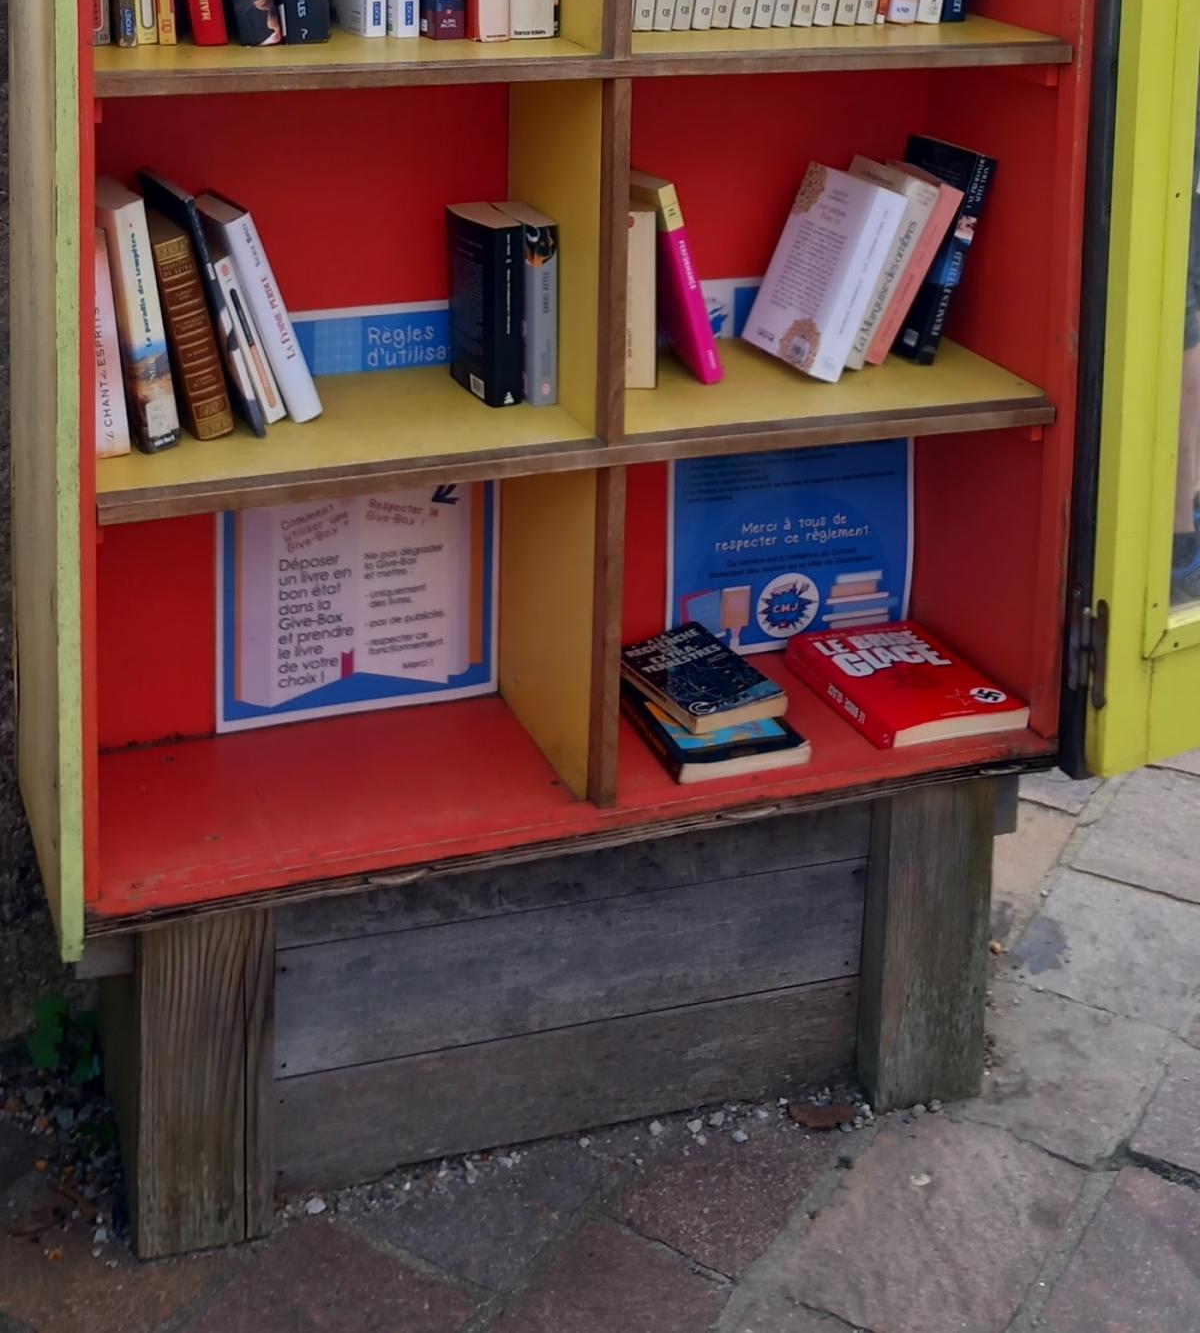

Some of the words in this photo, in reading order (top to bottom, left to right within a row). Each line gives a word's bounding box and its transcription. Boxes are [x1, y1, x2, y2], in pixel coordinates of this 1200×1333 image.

[131, 232, 142, 278] tempêtes
[678, 240, 698, 291] PERFORMANCE
[137, 279, 145, 296] des
[261, 277, 277, 309] PERDUE
[853, 335, 867, 352] La
[860, 283, 890, 335] Marquise
[894, 220, 917, 264] ombres
[140, 298, 152, 335] paradis
[931, 294, 950, 337] FRANCES
[94, 308, 106, 367] ESPRITS
[274, 313, 290, 344] FEMME
[368, 325, 435, 347] Règles
[286, 345, 296, 359] LA
[367, 344, 450, 366] d'utilisa
[100, 382, 113, 427] CHANT
[368, 498, 424, 514] Respecter
[280, 504, 335, 531] Comment
[284, 521, 323, 543] utiliser
[329, 511, 350, 525] une
[366, 510, 415, 525] Give-Box
[741, 521, 778, 535] Merci
[783, 518, 792, 531] à
[799, 514, 826, 527] tous
[833, 513, 847, 525] de
[286, 527, 338, 554] Give-Box
[714, 536, 778, 553] respecter
[784, 534, 800, 544] ce
[805, 525, 870, 544] règlement
[364, 552, 378, 560] Ne
[380, 550, 397, 561] pas
[400, 544, 444, 557] dégrader
[279, 554, 340, 572] Déposer
[376, 557, 417, 569] Give-Box
[278, 575, 298, 586] un
[301, 568, 329, 584] livre
[333, 567, 352, 580] en
[376, 568, 408, 578] mettre
[278, 586, 308, 601] bon
[312, 582, 342, 597] état
[370, 584, 427, 598] uniquement
[278, 601, 314, 616] dans
[317, 600, 331, 611] la
[369, 600, 387, 608] des
[772, 603, 799, 614] CMJ
[278, 613, 343, 630] Give-Box
[369, 620, 387, 629] pas
[389, 616, 402, 624] de
[278, 632, 293, 645] et
[297, 625, 354, 644] prendre
[369, 634, 414, 645] respecter
[416, 632, 429, 640] ce
[625, 628, 701, 658] RECHERCHE
[813, 639, 850, 656] LE
[846, 630, 925, 649] BRISE
[278, 647, 291, 659] le
[294, 644, 324, 658] livre
[641, 644, 722, 673] TERRESTRES
[831, 643, 953, 677] GLACE
[278, 661, 298, 674] de
[302, 656, 339, 670] votre
[402, 660, 428, 669] Merci
[278, 673, 317, 688] choix
